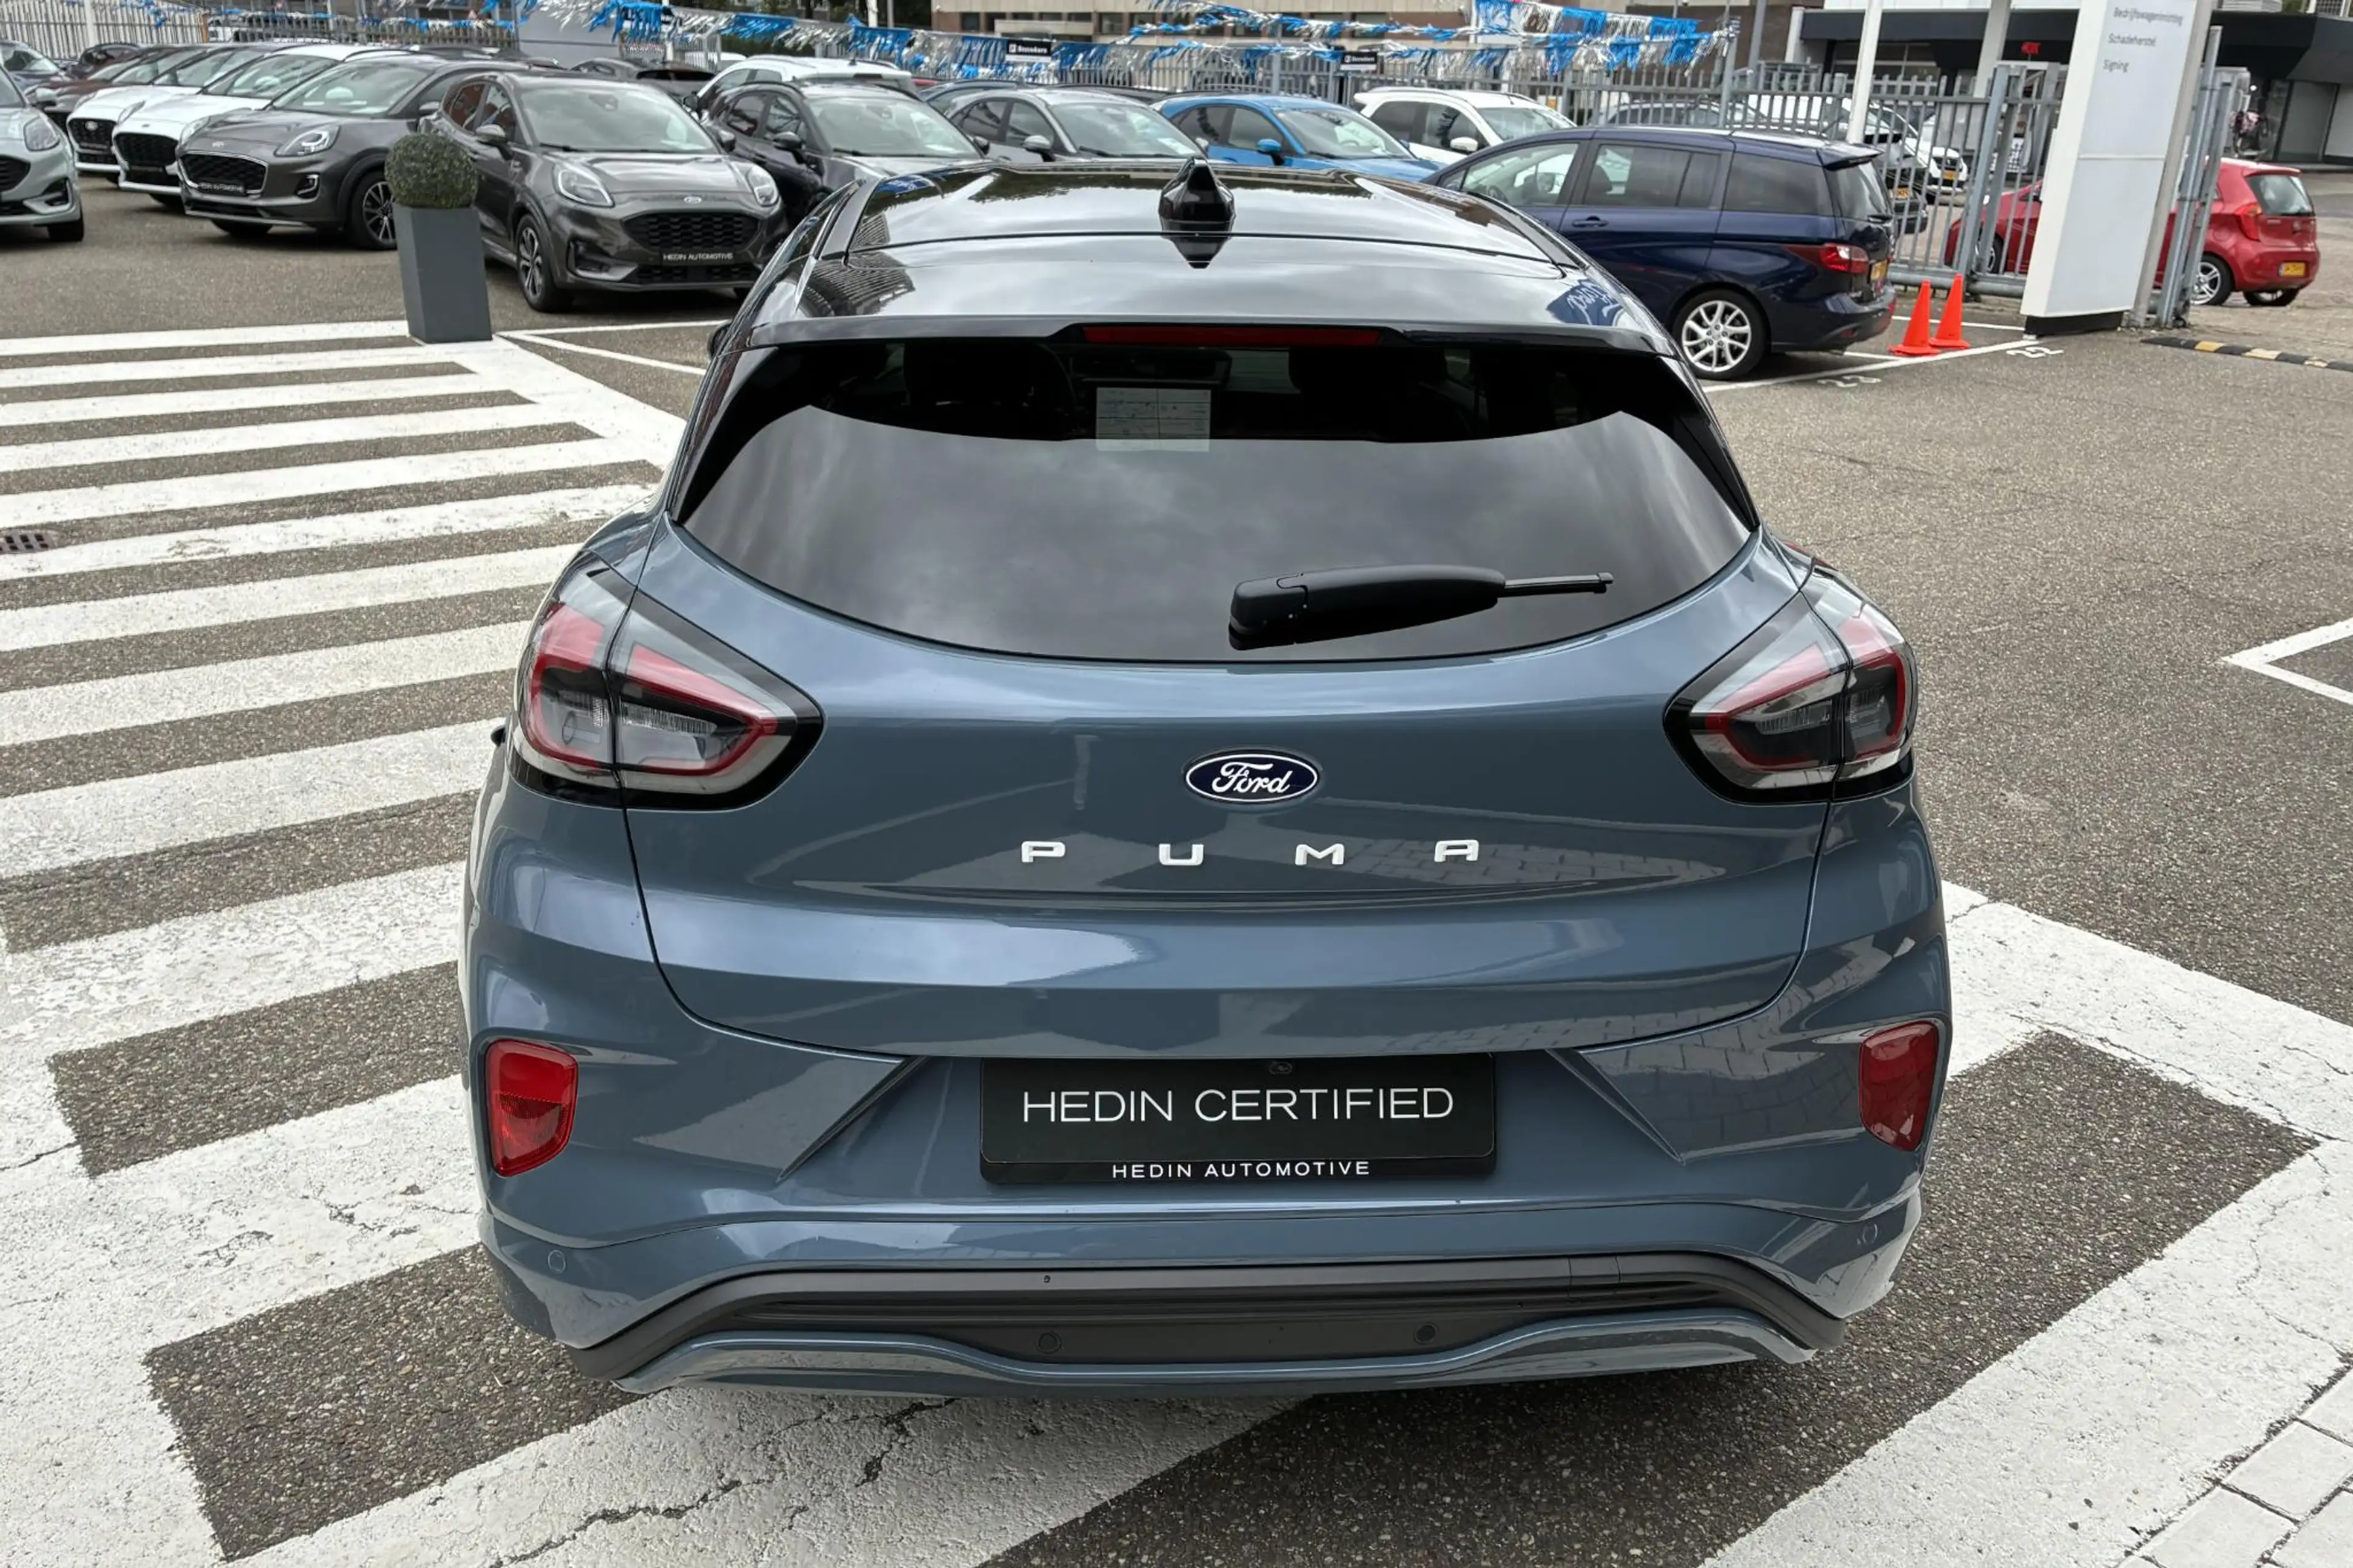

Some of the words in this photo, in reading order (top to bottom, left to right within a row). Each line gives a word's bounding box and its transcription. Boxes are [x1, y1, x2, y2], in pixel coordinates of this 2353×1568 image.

[1211, 762, 1294, 793] Ford
[1021, 840, 1479, 866] PUMA
[1023, 1090, 1173, 1123] HEDIN
[1195, 1088, 1453, 1122] CERTIFIED
[1112, 1163, 1192, 1178] HEDIN
[1204, 1161, 1370, 1177] AUTOMOTIVE
